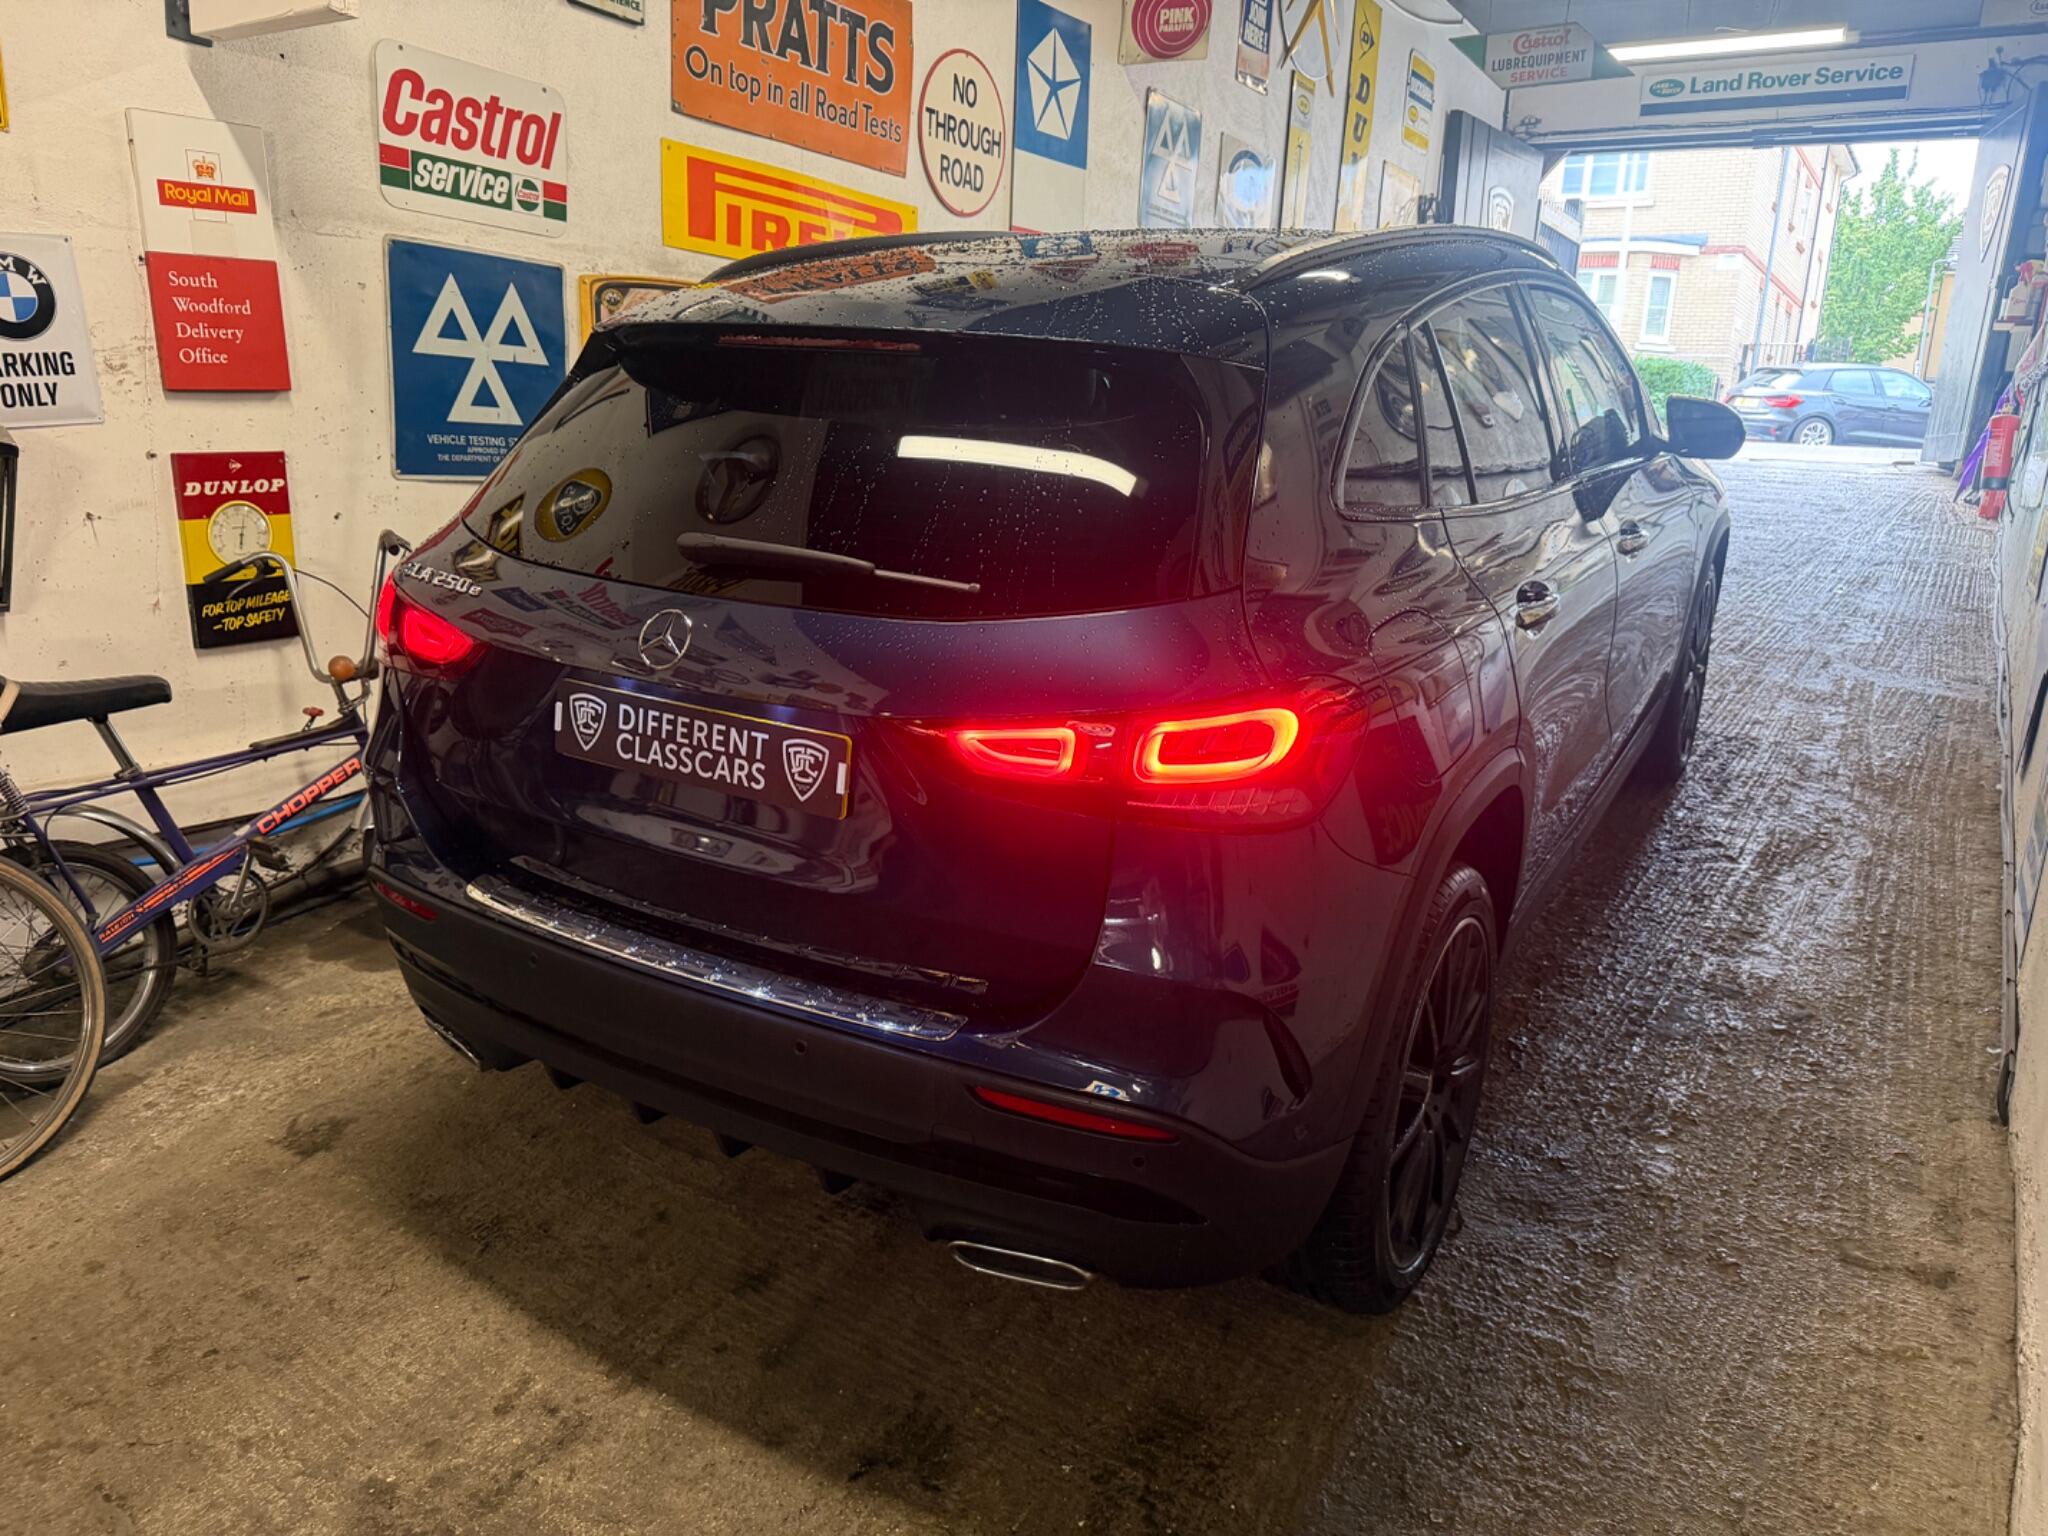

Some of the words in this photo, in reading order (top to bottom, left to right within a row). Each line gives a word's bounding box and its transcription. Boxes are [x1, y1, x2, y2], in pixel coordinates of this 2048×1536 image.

[1159, 23, 1194, 33] PARAFFIN
[1160, 7, 1195, 24] PINK
[701, 0, 895, 95] PRATTS
[1513, 28, 1571, 55] Castrol
[1491, 49, 1587, 72] LUBREQUIPMENT
[1510, 66, 1568, 82] SERVICE
[1690, 76, 1741, 95] Land
[1746, 71, 1811, 90] Rover
[1814, 63, 1903, 85] Service
[685, 45, 722, 86] On
[729, 62, 761, 103] top
[767, 74, 783, 106] in
[789, 82, 810, 114] all
[815, 87, 859, 130] Road
[862, 104, 902, 143] Tests
[953, 73, 977, 108] NO
[382, 68, 562, 171] Castrol
[925, 107, 1002, 159] THROUGH
[414, 158, 510, 204] service
[939, 154, 984, 193] ROAD
[164, 182, 211, 204] Royal
[215, 189, 249, 207] Mail
[168, 271, 218, 288] South
[172, 296, 251, 315] Woodford
[176, 322, 243, 343] Delivery
[179, 347, 228, 364] Office
[0, 382, 58, 408] ONLY
[427, 434, 466, 445] VEHICLE
[468, 435, 506, 447] TESTING
[437, 454, 449, 462] THE
[451, 454, 491, 463] DEPARTMENT
[184, 478, 285, 496] DUNLOP
[437, 571, 482, 596] 250e
[202, 602, 224, 618] FOR
[225, 597, 244, 614] TOP
[246, 589, 290, 611] MILEAGE
[244, 607, 286, 628] SAFETY
[618, 703, 770, 761] DIFFERENT
[615, 731, 766, 791] CLASSCARS
[256, 757, 362, 835] CHOPPER
[99, 912, 135, 940] RALEIGH
